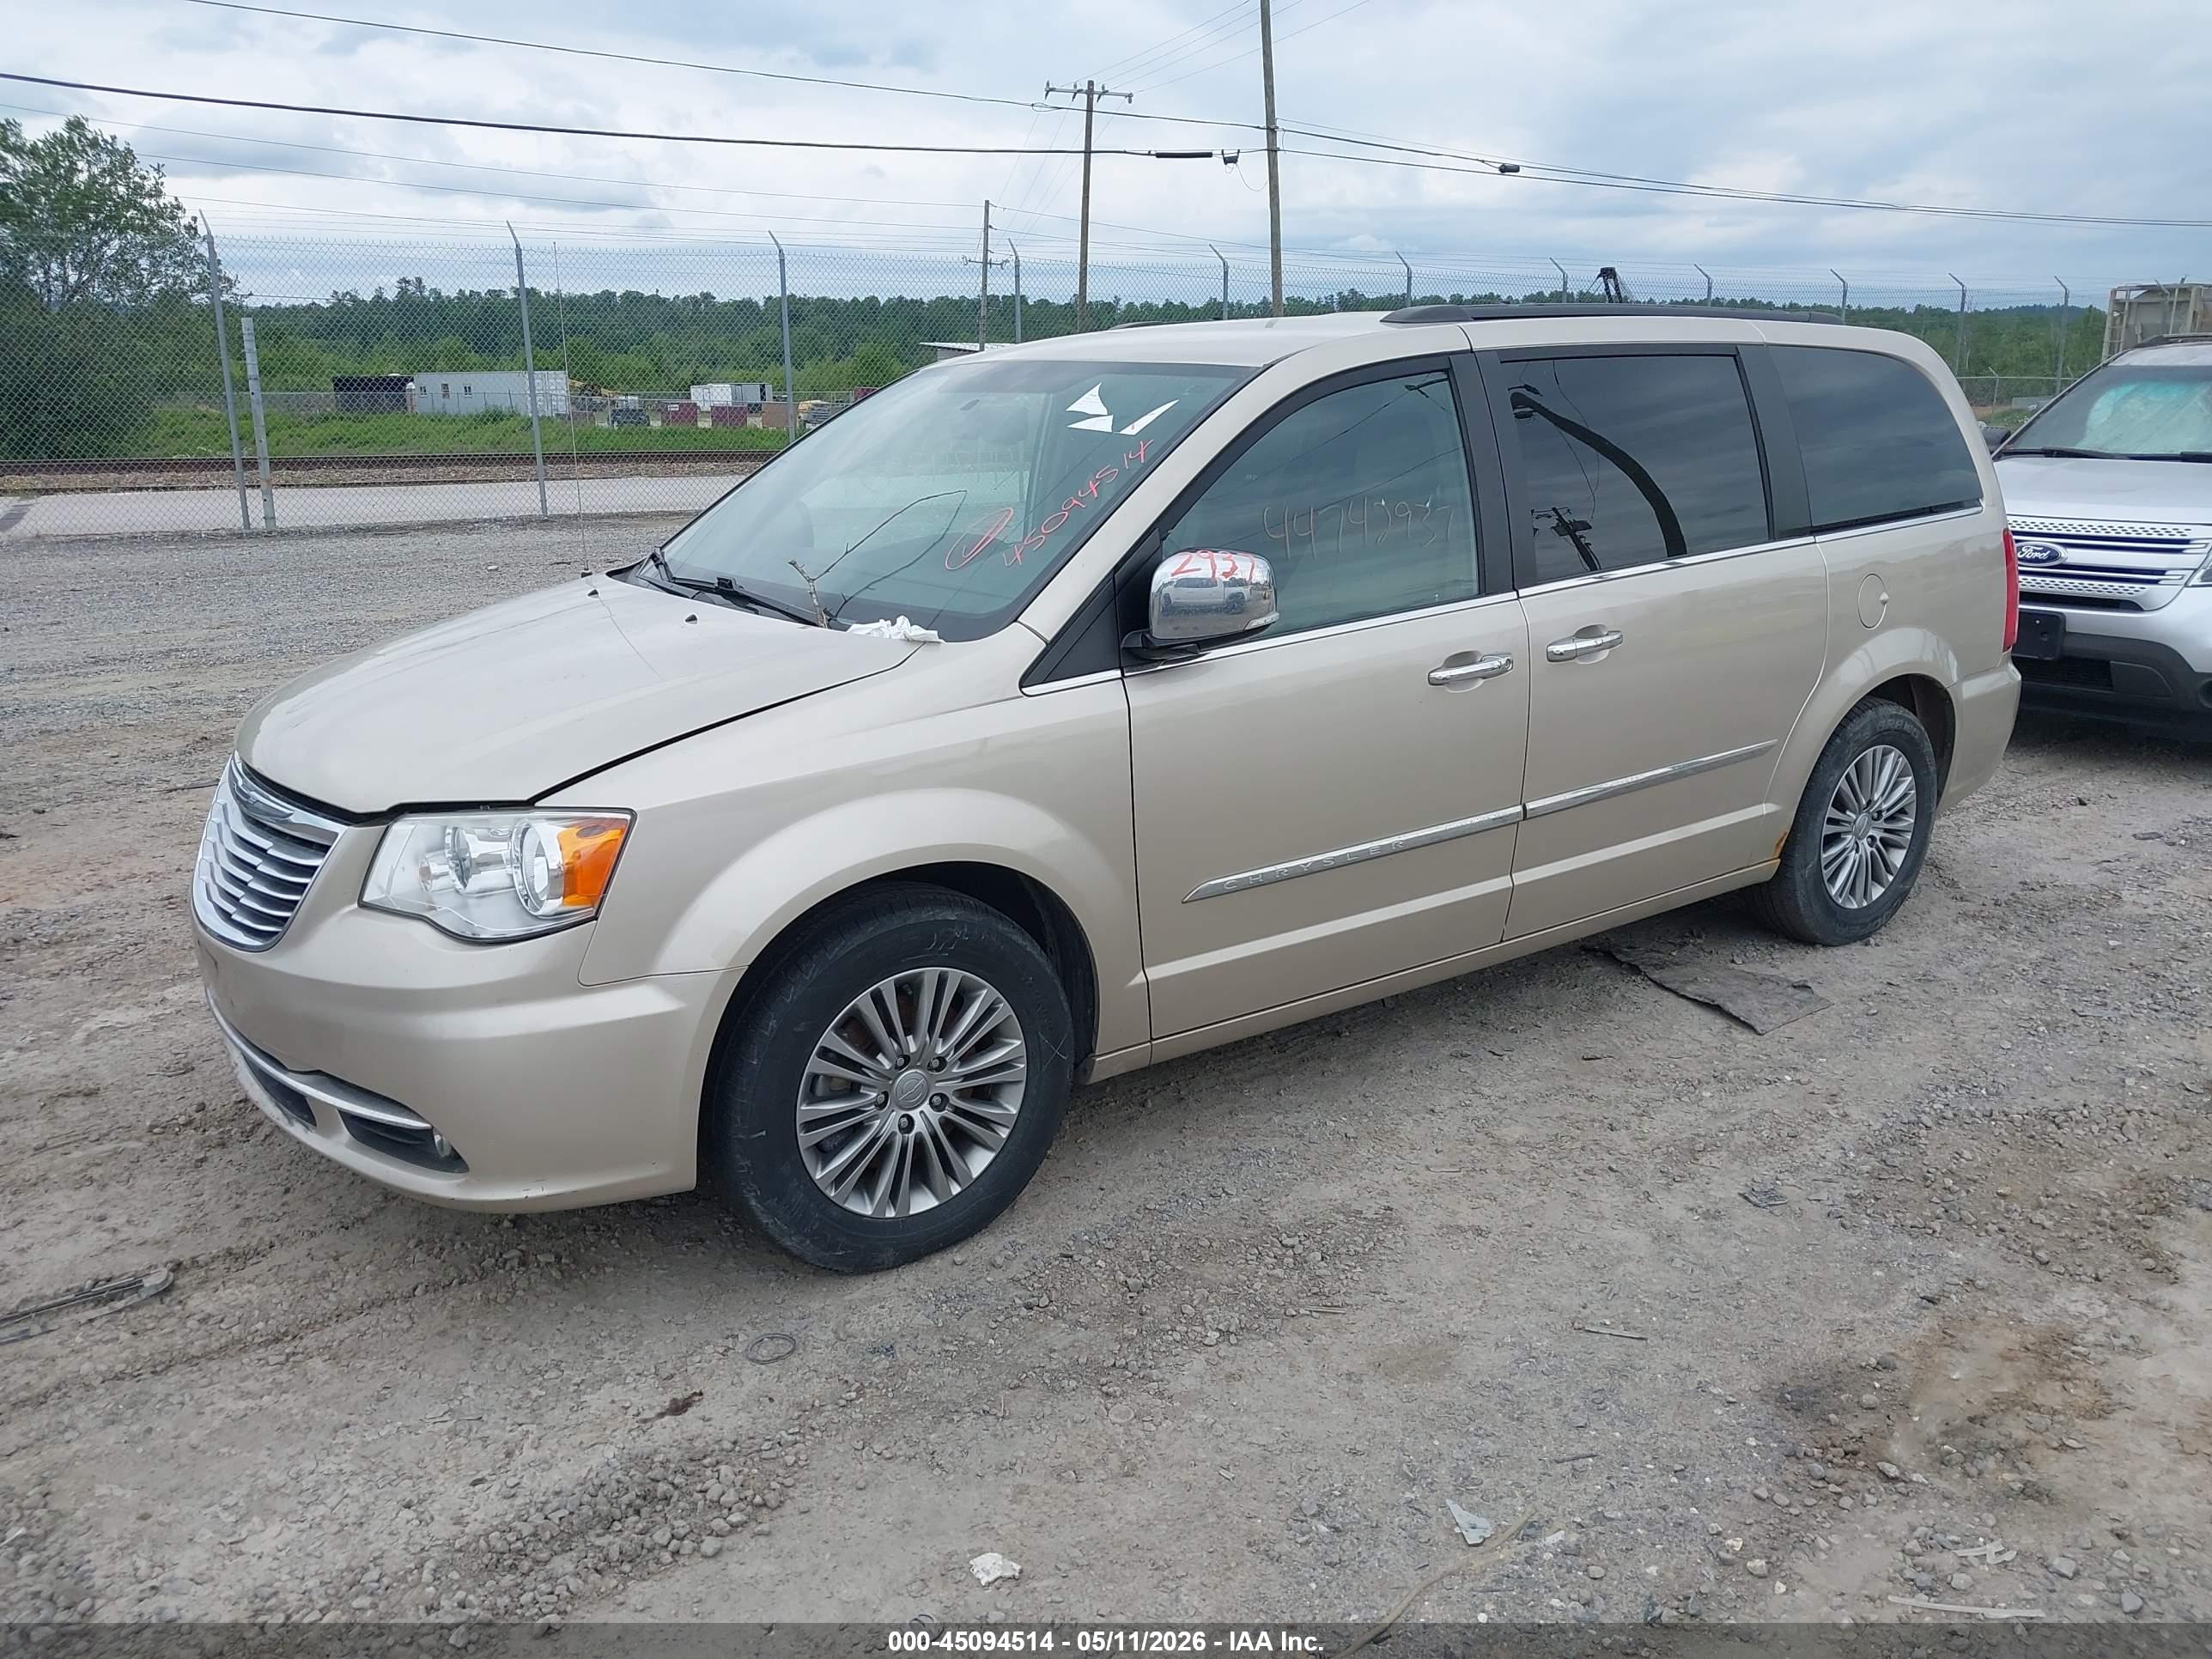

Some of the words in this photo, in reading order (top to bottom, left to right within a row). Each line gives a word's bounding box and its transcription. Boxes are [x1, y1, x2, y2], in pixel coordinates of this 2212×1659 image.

[1262, 494, 1456, 561] 44742937
[1170, 550, 1255, 586] 2937
[2017, 545, 2050, 560] Ford
[1223, 839, 1406, 890] CHRYSLER
